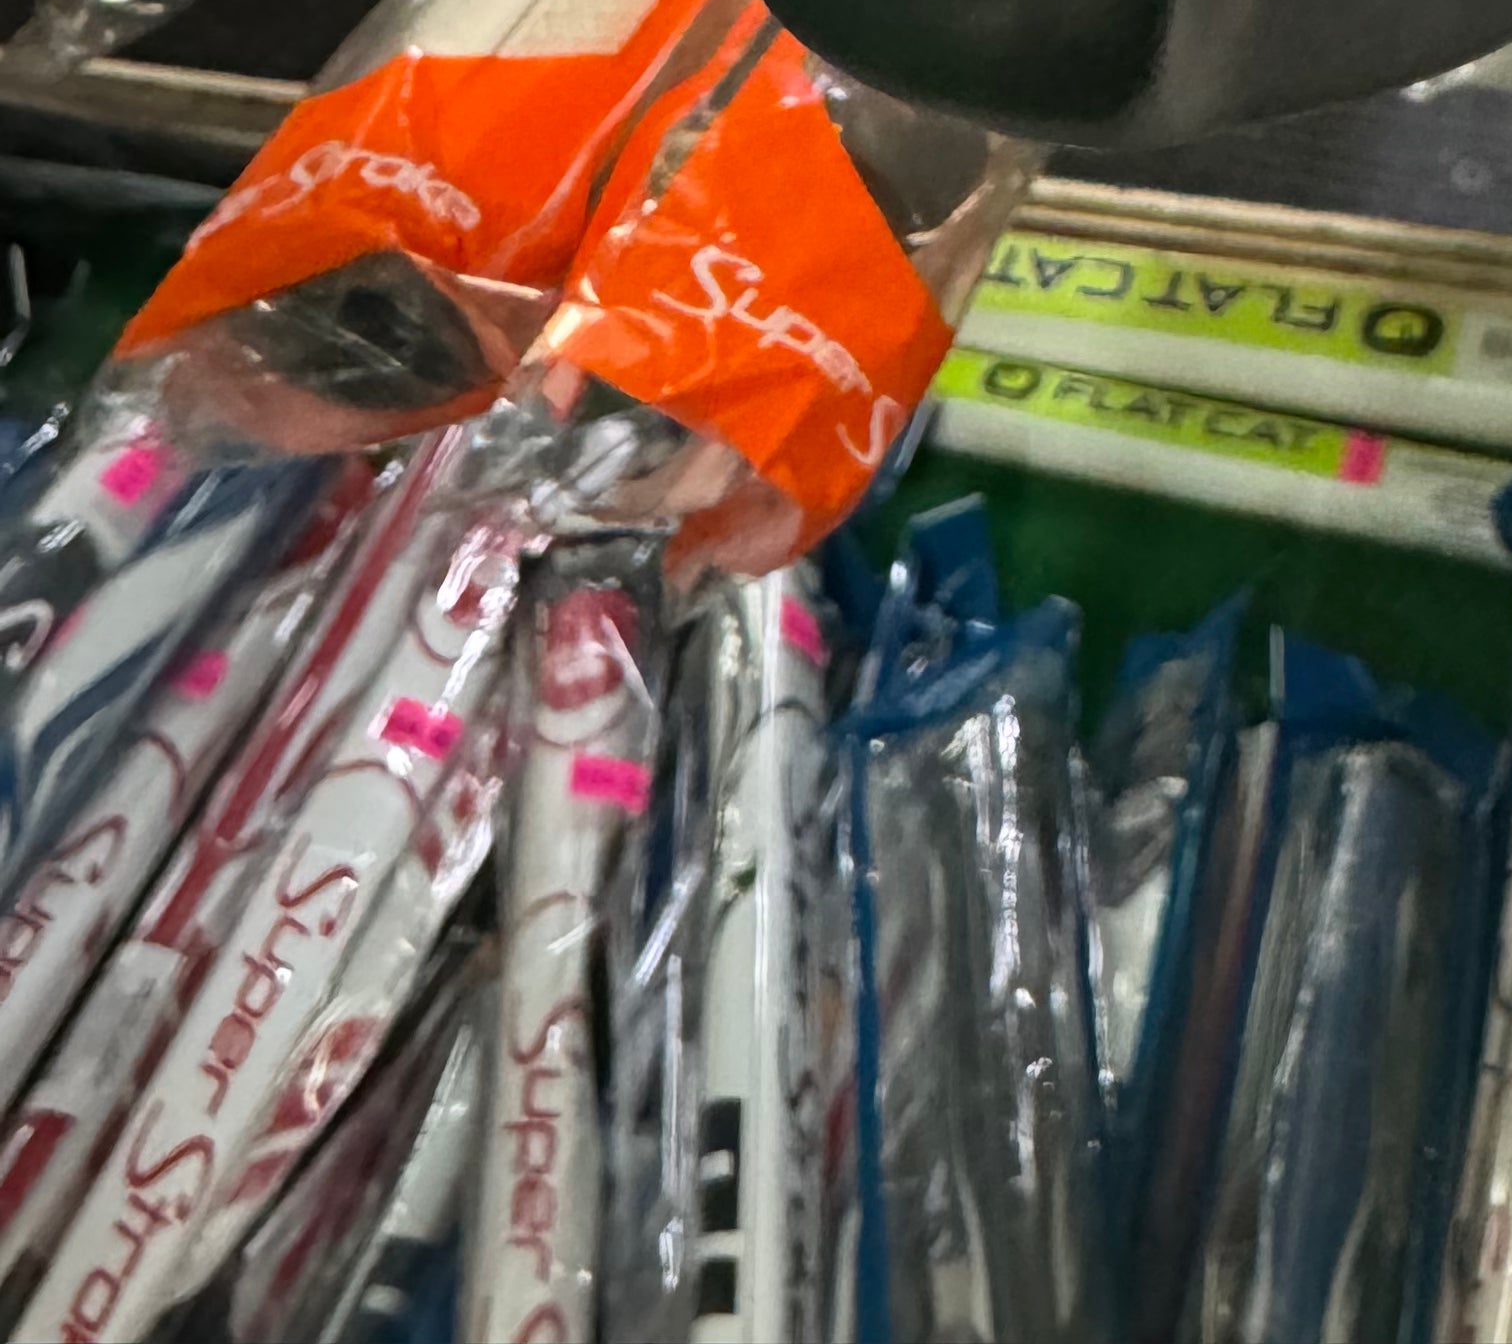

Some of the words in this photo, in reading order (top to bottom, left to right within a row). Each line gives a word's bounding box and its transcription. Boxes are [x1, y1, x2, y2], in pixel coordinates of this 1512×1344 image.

[651, 244, 873, 393] Super
[985, 245, 1134, 301] CAT
[1141, 270, 1339, 332] FLAT
[201, 833, 359, 1117] Super
[500, 988, 589, 1284] Super
